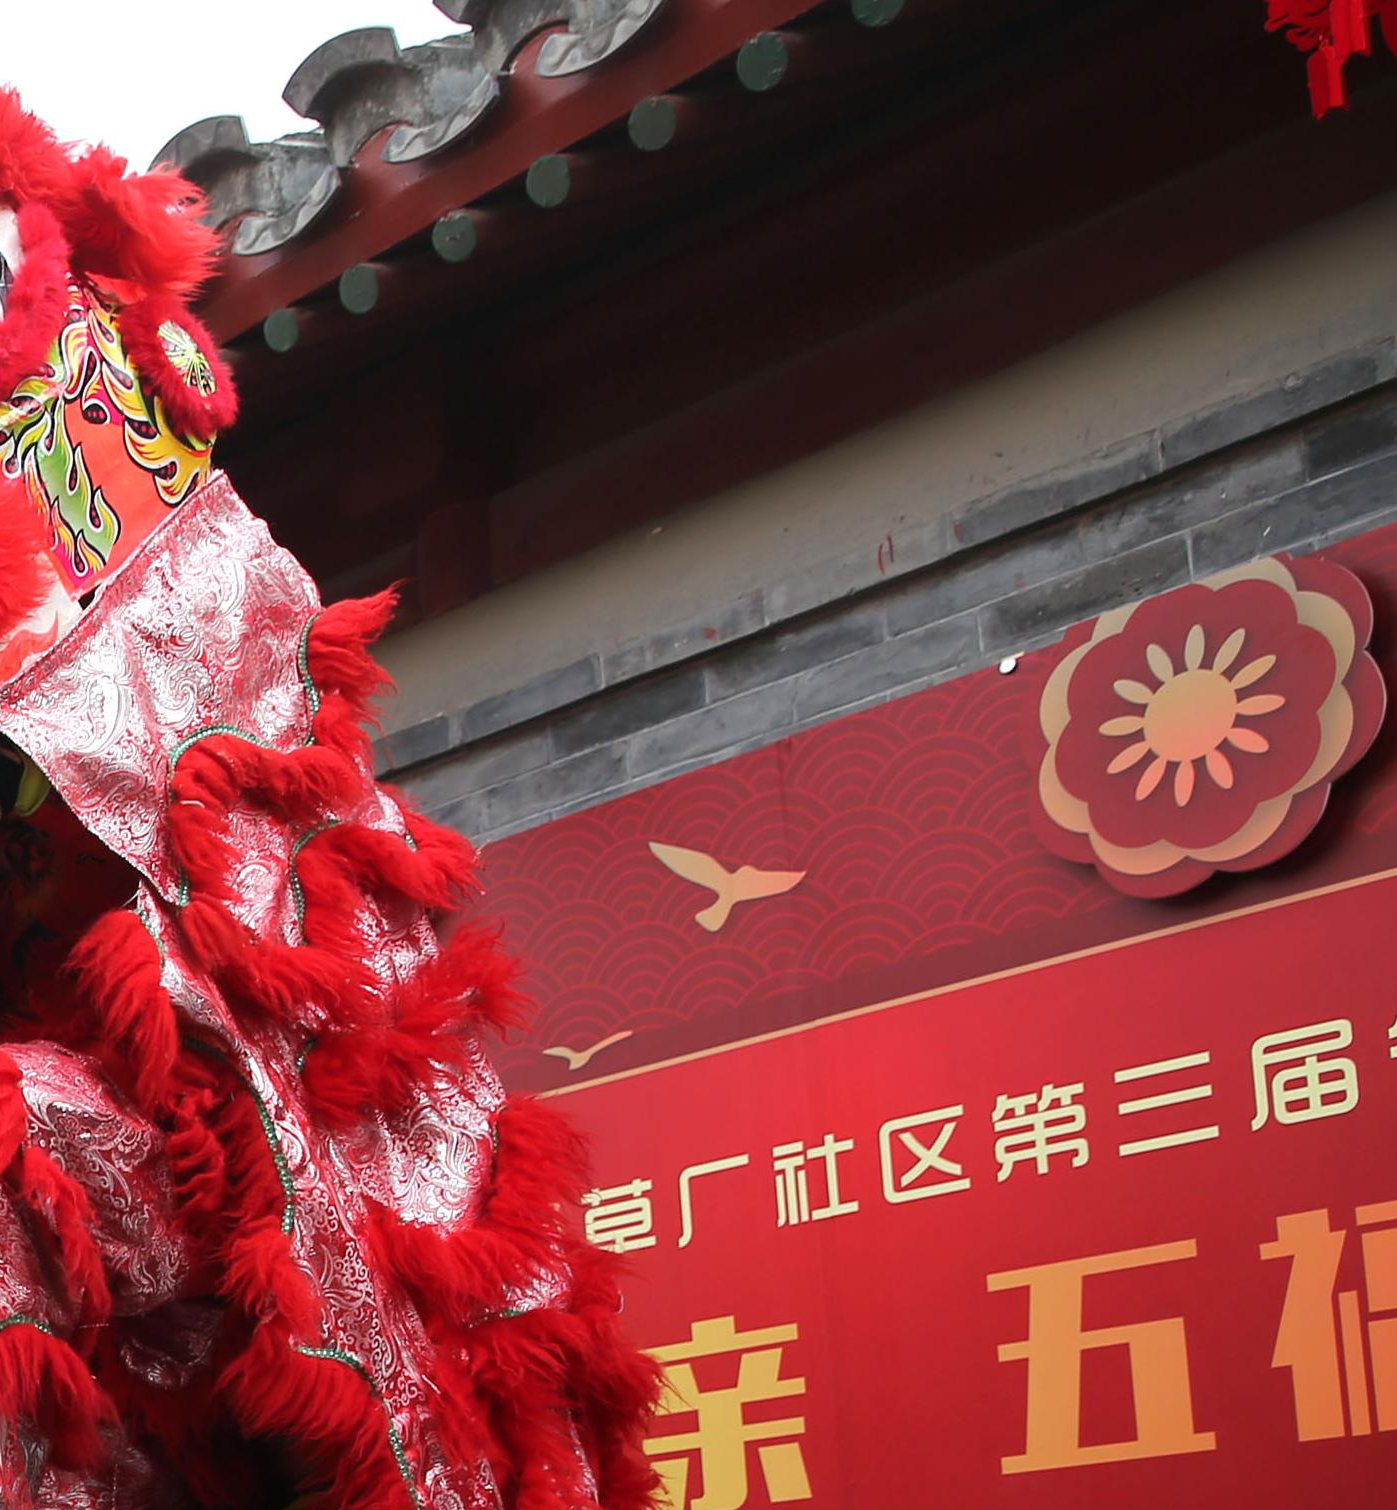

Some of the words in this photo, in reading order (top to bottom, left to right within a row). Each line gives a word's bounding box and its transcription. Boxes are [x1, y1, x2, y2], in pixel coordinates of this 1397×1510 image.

[580, 1014, 1397, 1255] 草厂社区第三届
